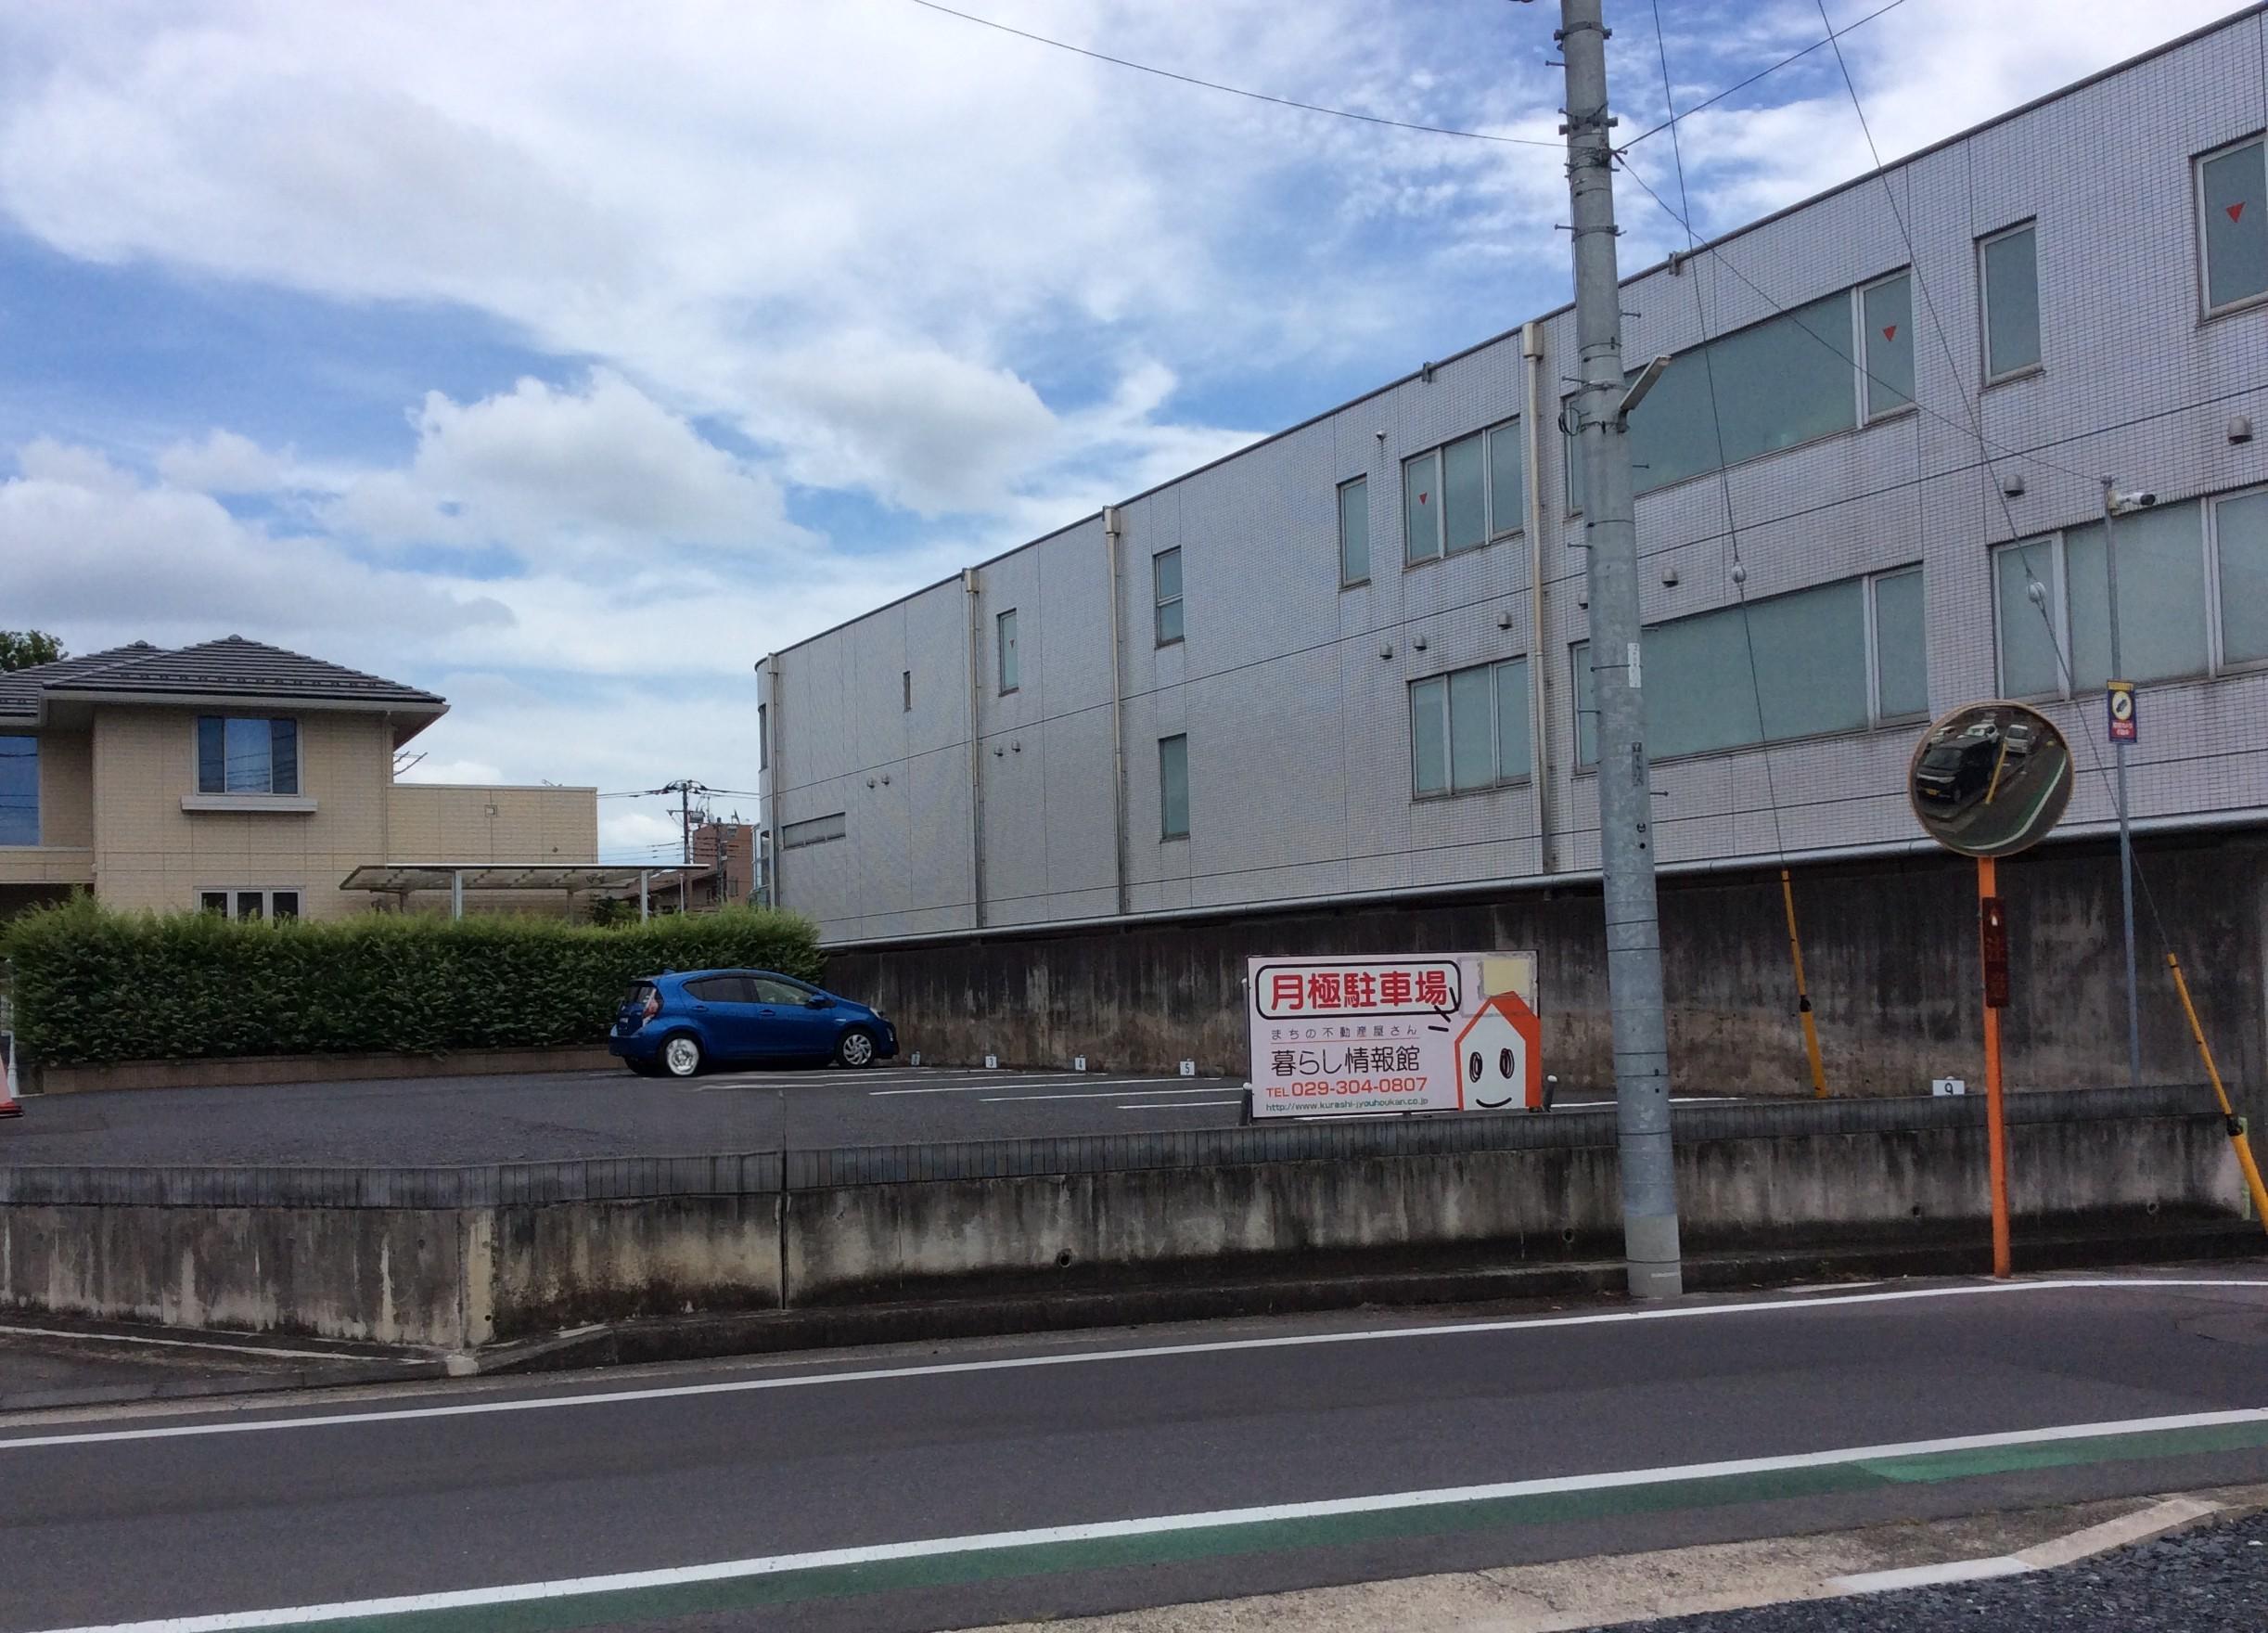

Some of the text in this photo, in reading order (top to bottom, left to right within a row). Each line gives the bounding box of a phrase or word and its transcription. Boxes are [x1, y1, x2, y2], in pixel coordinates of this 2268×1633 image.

[1271, 970, 1449, 1010] 月極駐車場
[1271, 1024, 1417, 1040] まちの不動産屋さん
[1271, 1045, 1420, 1076] 暮らし情報館
[1266, 1077, 1428, 1098] TEL 029-304-0807
[1944, 1082, 1954, 1095] 9
